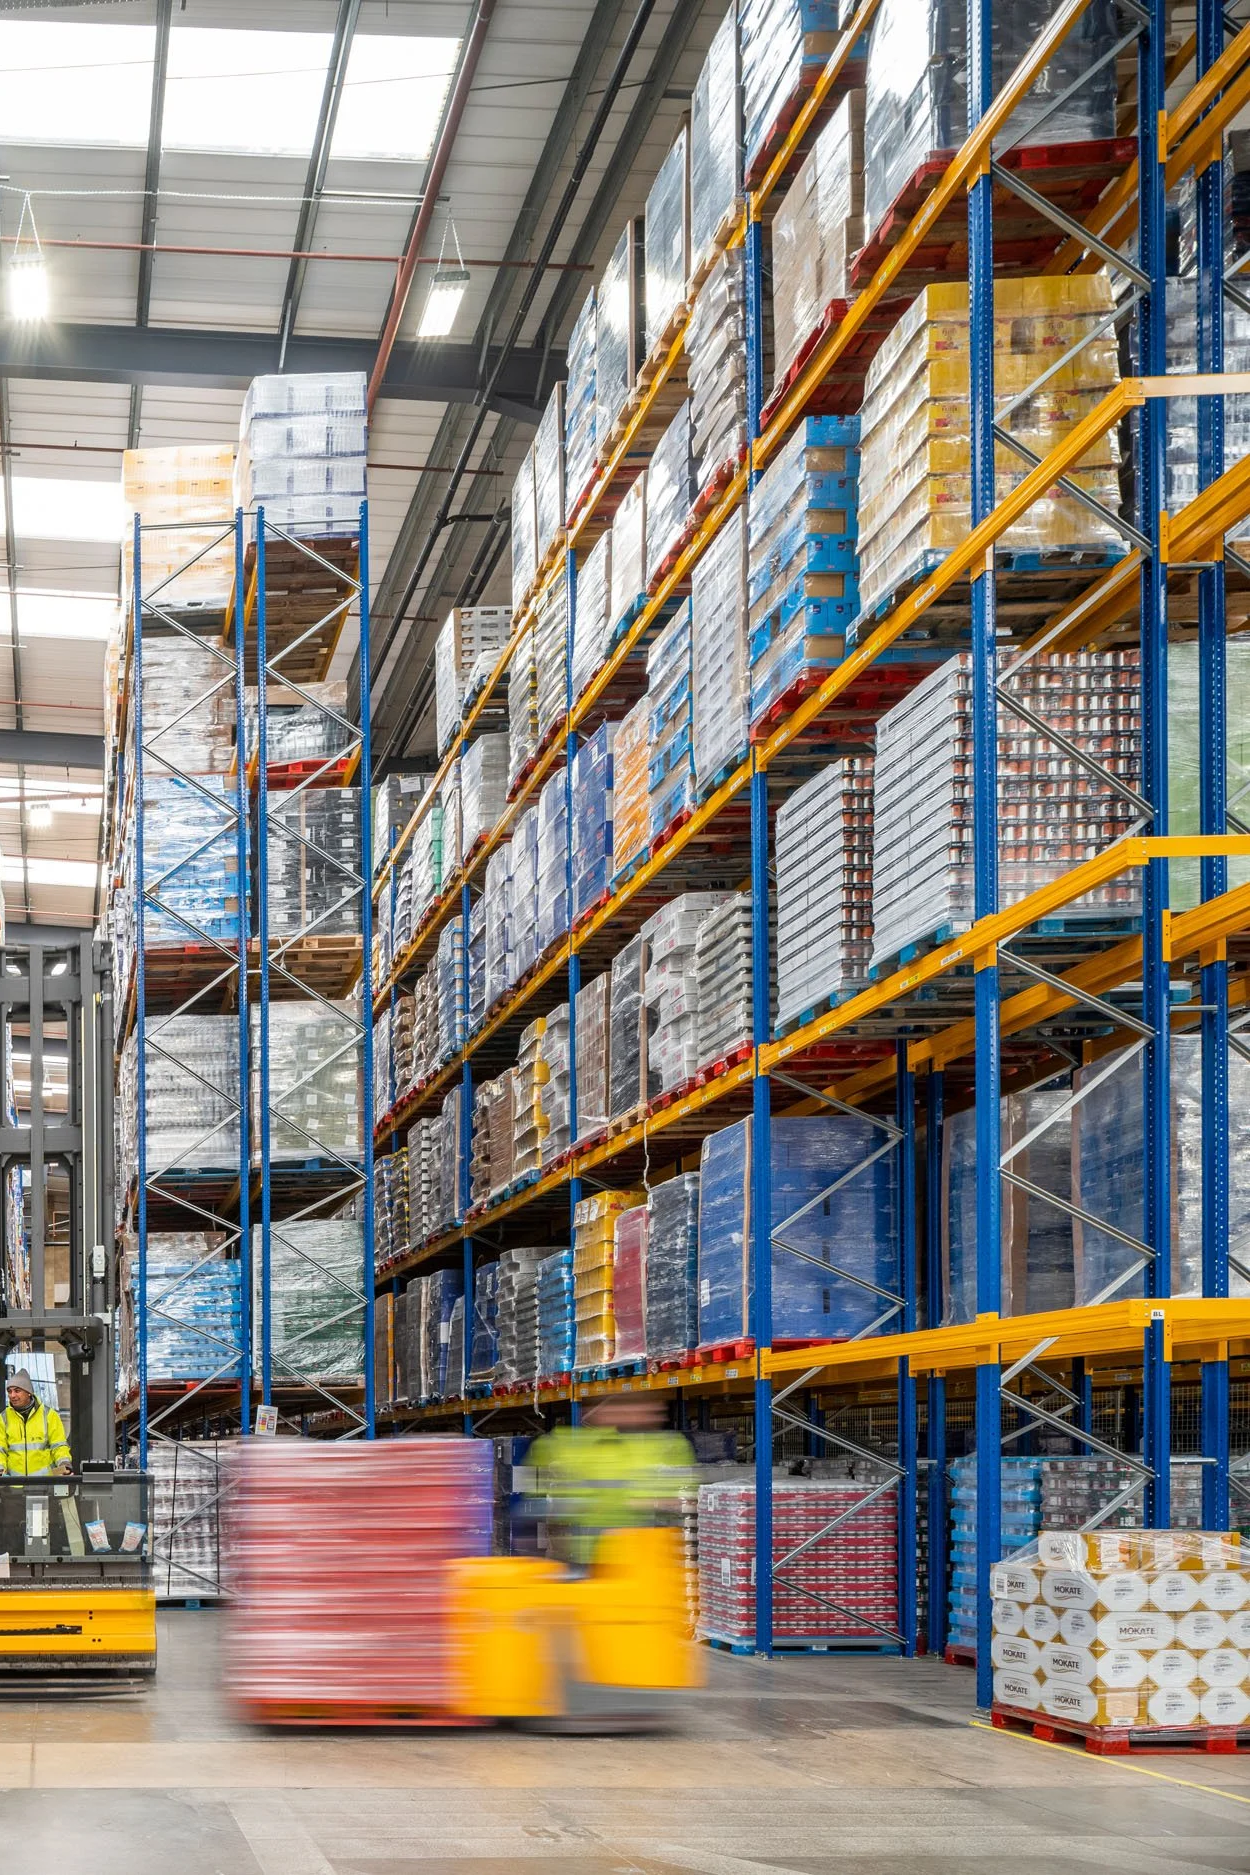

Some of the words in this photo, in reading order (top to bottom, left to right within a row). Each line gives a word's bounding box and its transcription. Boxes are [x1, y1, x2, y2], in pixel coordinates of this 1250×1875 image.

[1006, 1580, 1025, 1589] OKATE
[1054, 1585, 1081, 1595] MOKATE
[1119, 1627, 1156, 1635] MOKATE
[1003, 1649, 1026, 1659] MOKATE
[1052, 1658, 1080, 1669] MOKATE
[1004, 1684, 1028, 1695] MOKATE
[1054, 1695, 1081, 1706] MOKATE
